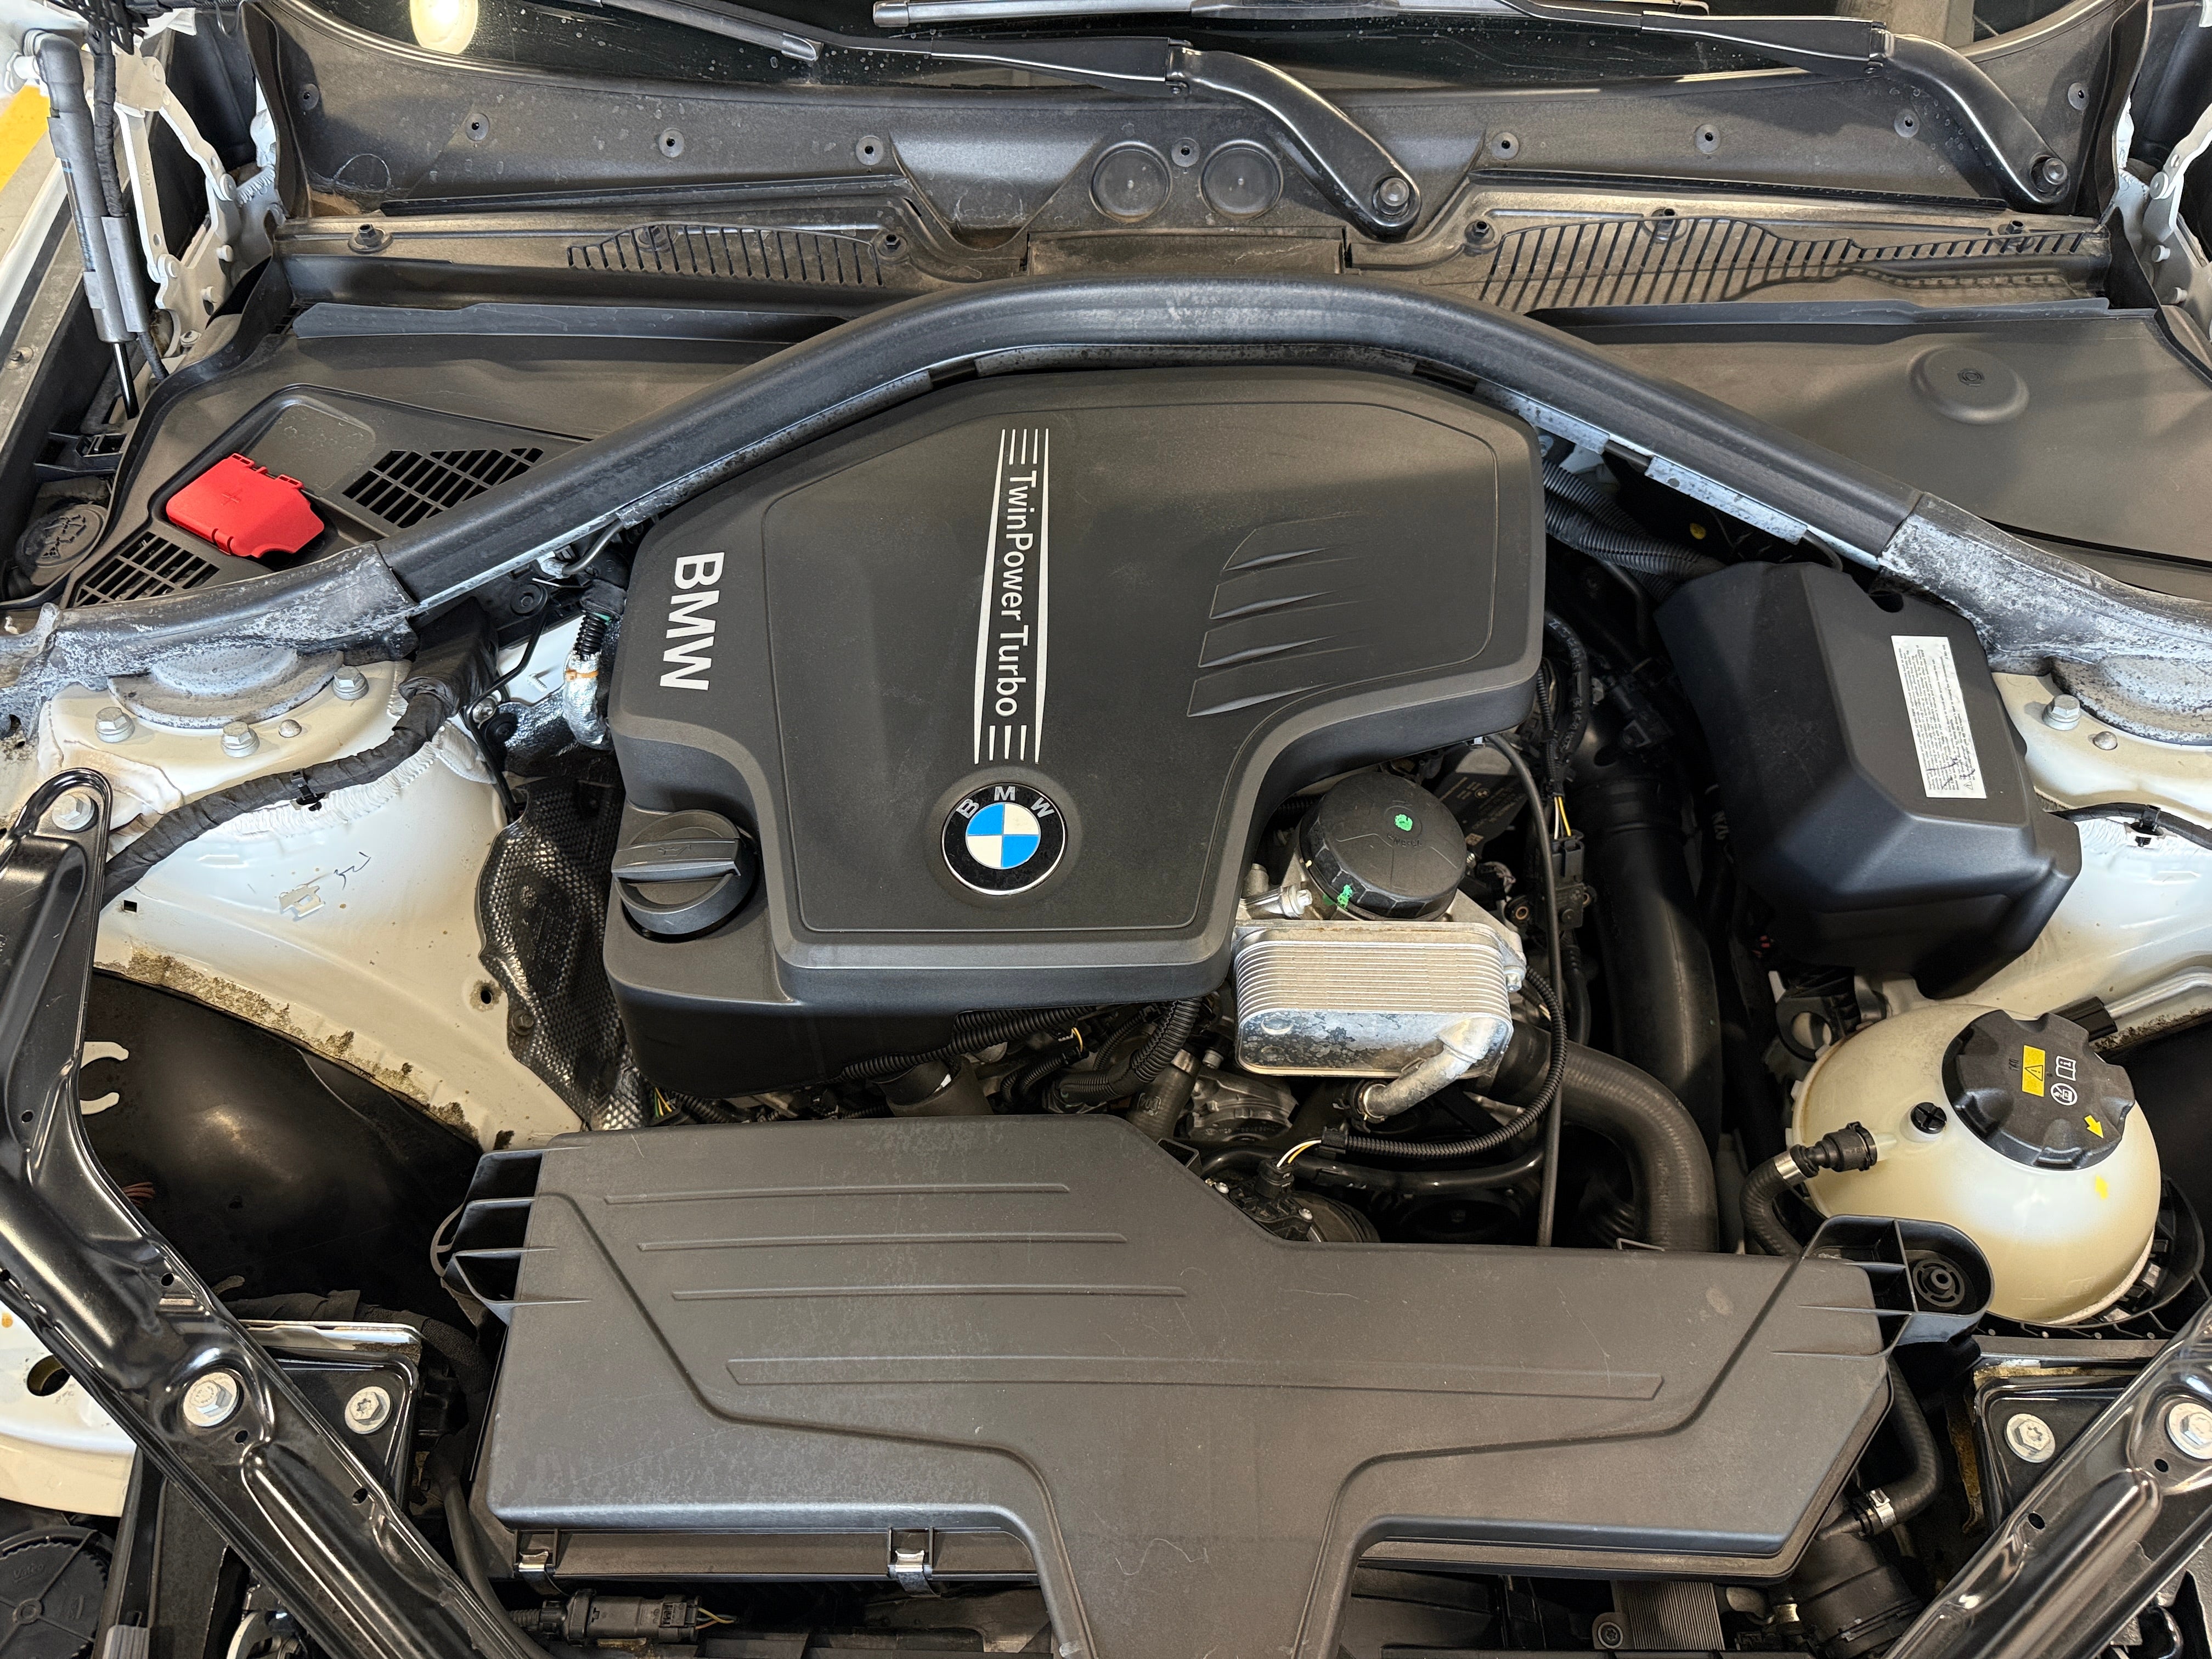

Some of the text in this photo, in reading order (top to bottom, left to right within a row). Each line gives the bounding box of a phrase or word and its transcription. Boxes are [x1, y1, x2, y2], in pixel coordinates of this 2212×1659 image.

[659, 552, 725, 691] BMW
[995, 470, 1037, 716] TwinPower Turbo
[956, 786, 1054, 819] BMW
